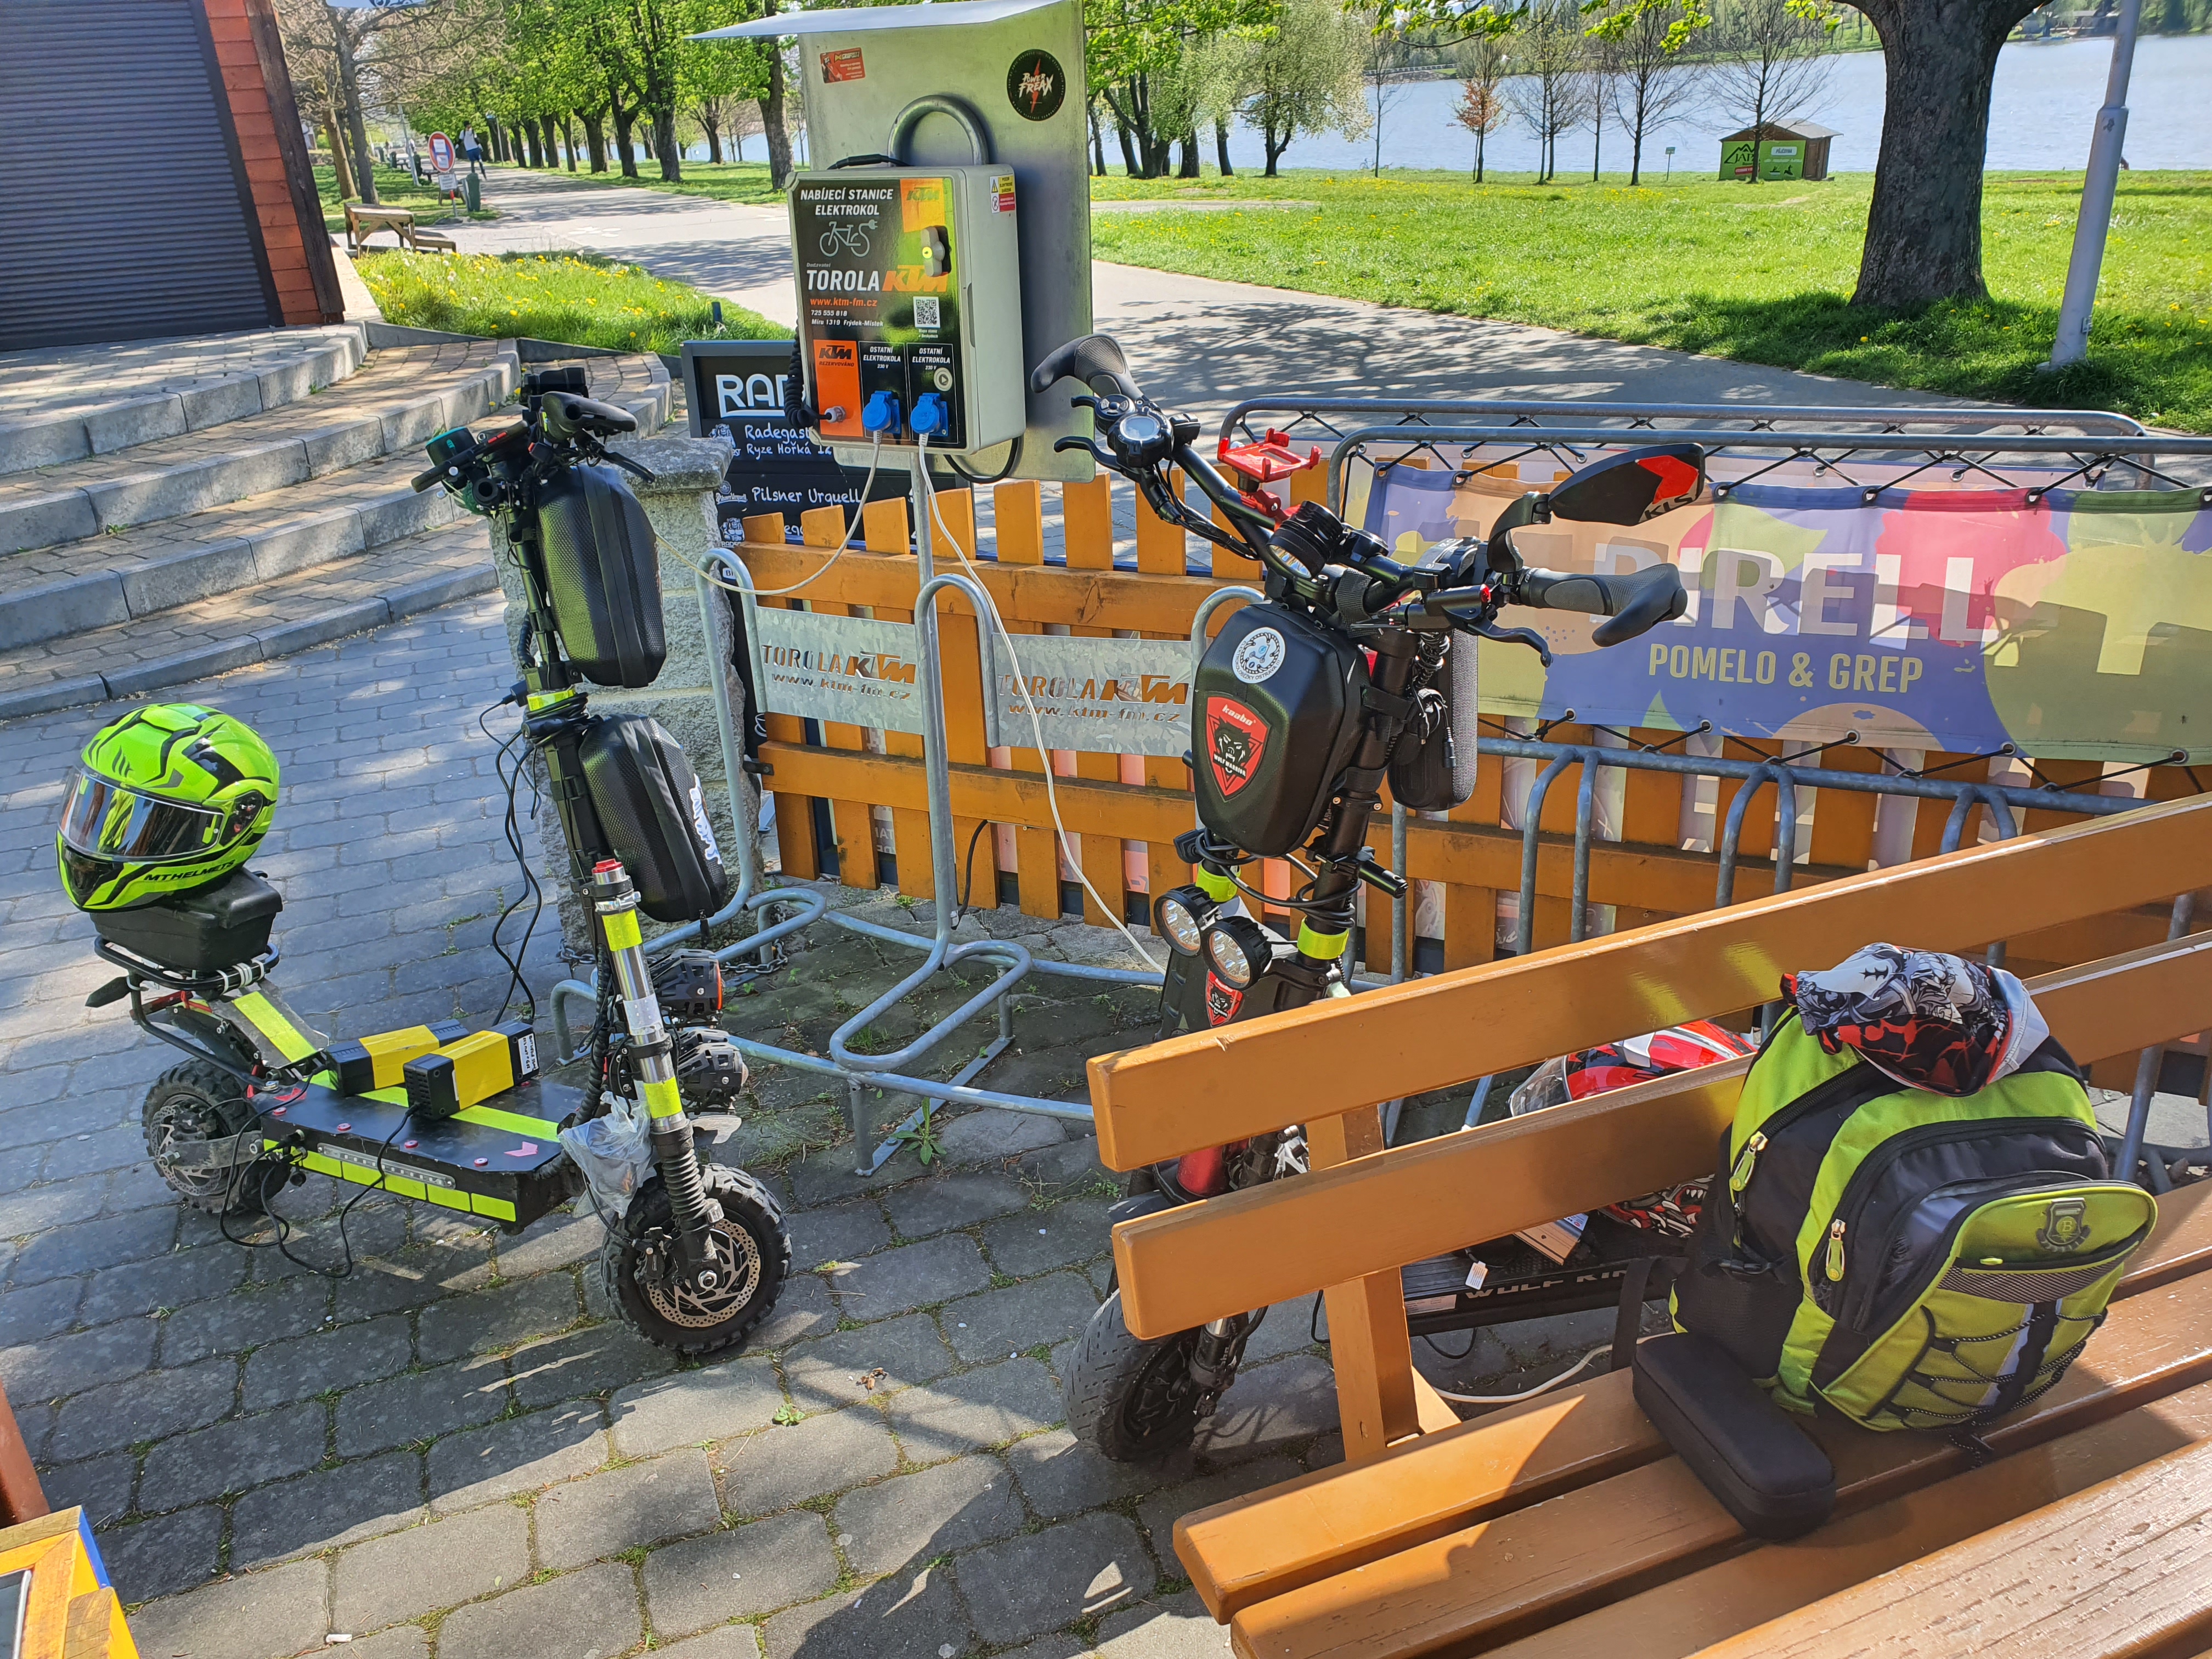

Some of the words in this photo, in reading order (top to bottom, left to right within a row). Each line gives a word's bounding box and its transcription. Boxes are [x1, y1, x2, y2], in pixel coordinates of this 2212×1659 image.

[1018, 74, 1053, 98] FREAX
[1022, 72, 1046, 83] POWER
[1733, 154, 1760, 163] JAP
[800, 187, 846, 200] NABÍJECÍ
[848, 189, 894, 200] STANICE
[906, 187, 940, 201] KTM
[815, 205, 879, 215] ELEKTROKOL
[807, 270, 879, 291] TOROLA
[882, 265, 948, 292] KTM
[810, 297, 877, 307] www.ktm-fm.cz
[819, 345, 852, 359] KTM
[747, 443, 772, 460] Ryze
[778, 441, 811, 454] Hořká
[752, 487, 802, 503] Pilsner
[808, 488, 861, 506] Urquell
[1645, 493, 1692, 520] KLS
[761, 645, 842, 675] TOROLA
[844, 651, 916, 685] KTM
[1255, 665, 1277, 680] OSTRAVA
[1649, 643, 1776, 685] POMELO
[1788, 652, 1814, 687] &
[1828, 653, 1923, 693] GREP
[998, 674, 1096, 701] TOROLA
[1099, 674, 1189, 706] KTM
[1222, 704, 1251, 726] kaabo
[1214, 753, 1226, 764] WOLF
[1225, 761, 1246, 776] WARRIOR
